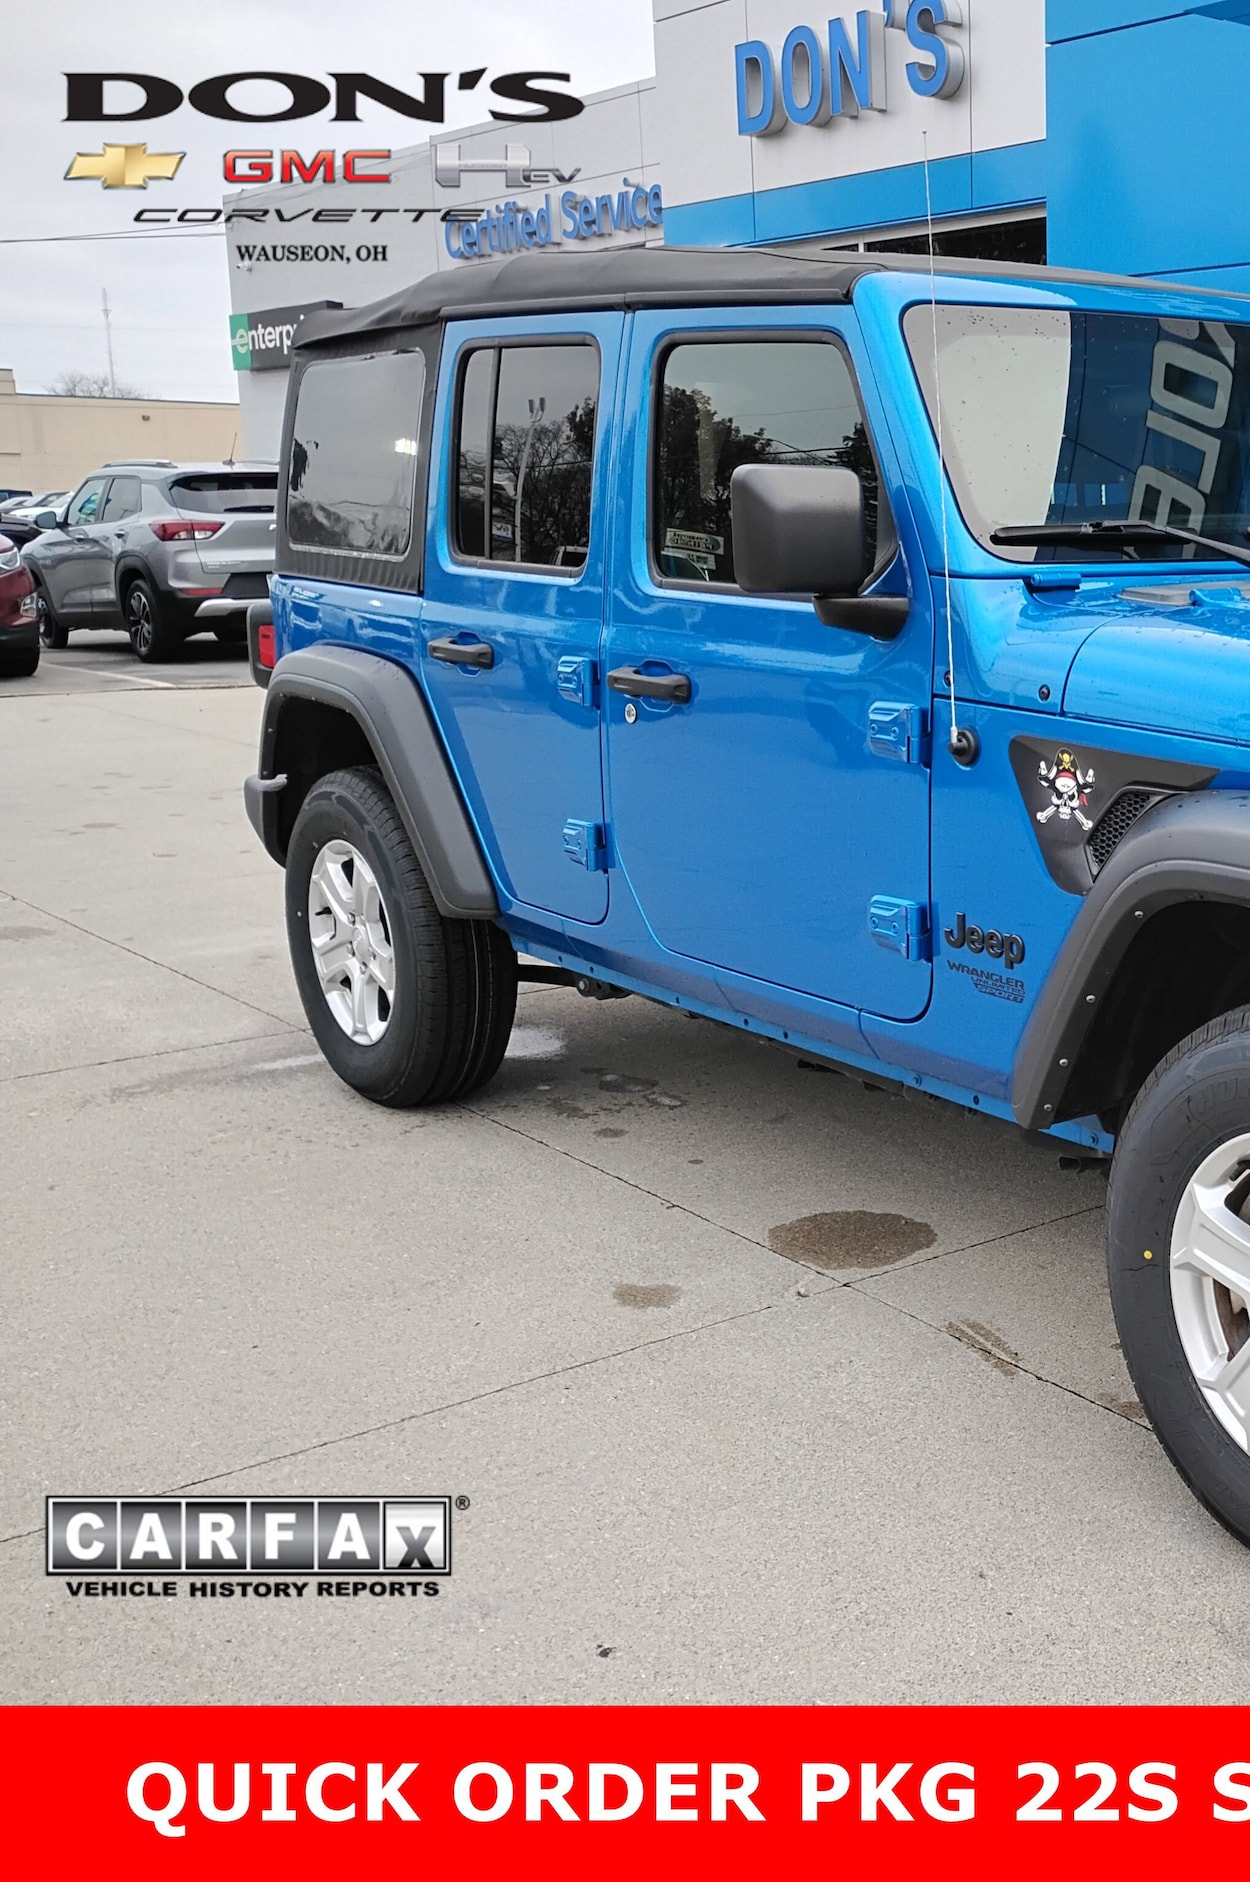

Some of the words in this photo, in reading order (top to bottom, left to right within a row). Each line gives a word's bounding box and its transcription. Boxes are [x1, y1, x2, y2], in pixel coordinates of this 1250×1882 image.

[734, 0, 964, 136] DON'S
[444, 193, 551, 260] Certified
[561, 176, 664, 241] Service
[944, 911, 1026, 970] Jeep
[946, 959, 1026, 990] WRANGLER
[971, 975, 1026, 996] UNLIMITED
[975, 983, 1025, 1003] SPORT
